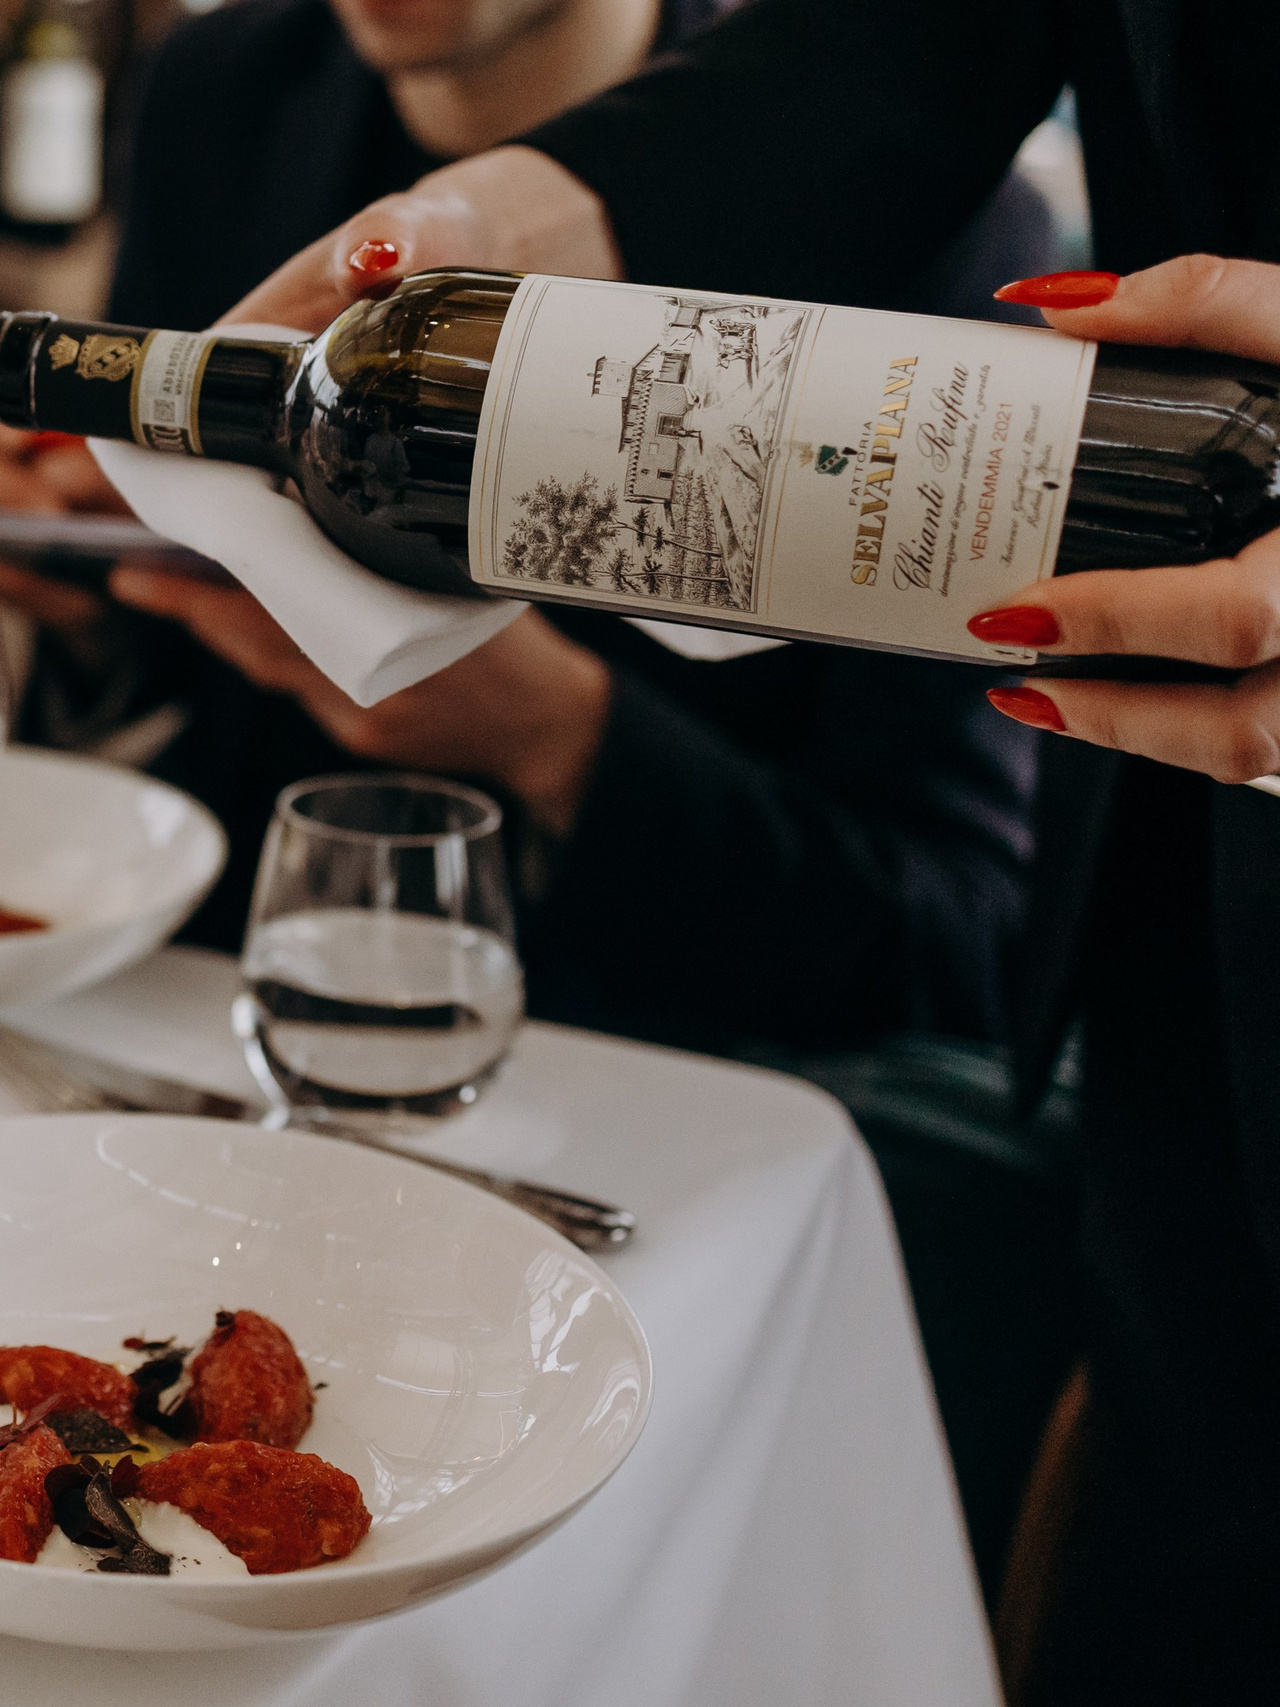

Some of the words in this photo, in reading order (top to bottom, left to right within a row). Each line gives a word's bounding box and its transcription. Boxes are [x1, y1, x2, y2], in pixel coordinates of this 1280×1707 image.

[849, 421, 872, 506] FATTORIA
[851, 356, 918, 587] SELVAPIANA
[916, 361, 969, 473] Rufina
[892, 480, 944, 591] Chianti
[968, 447, 1003, 561] VENDEMMIA
[991, 402, 1013, 442] 2021
